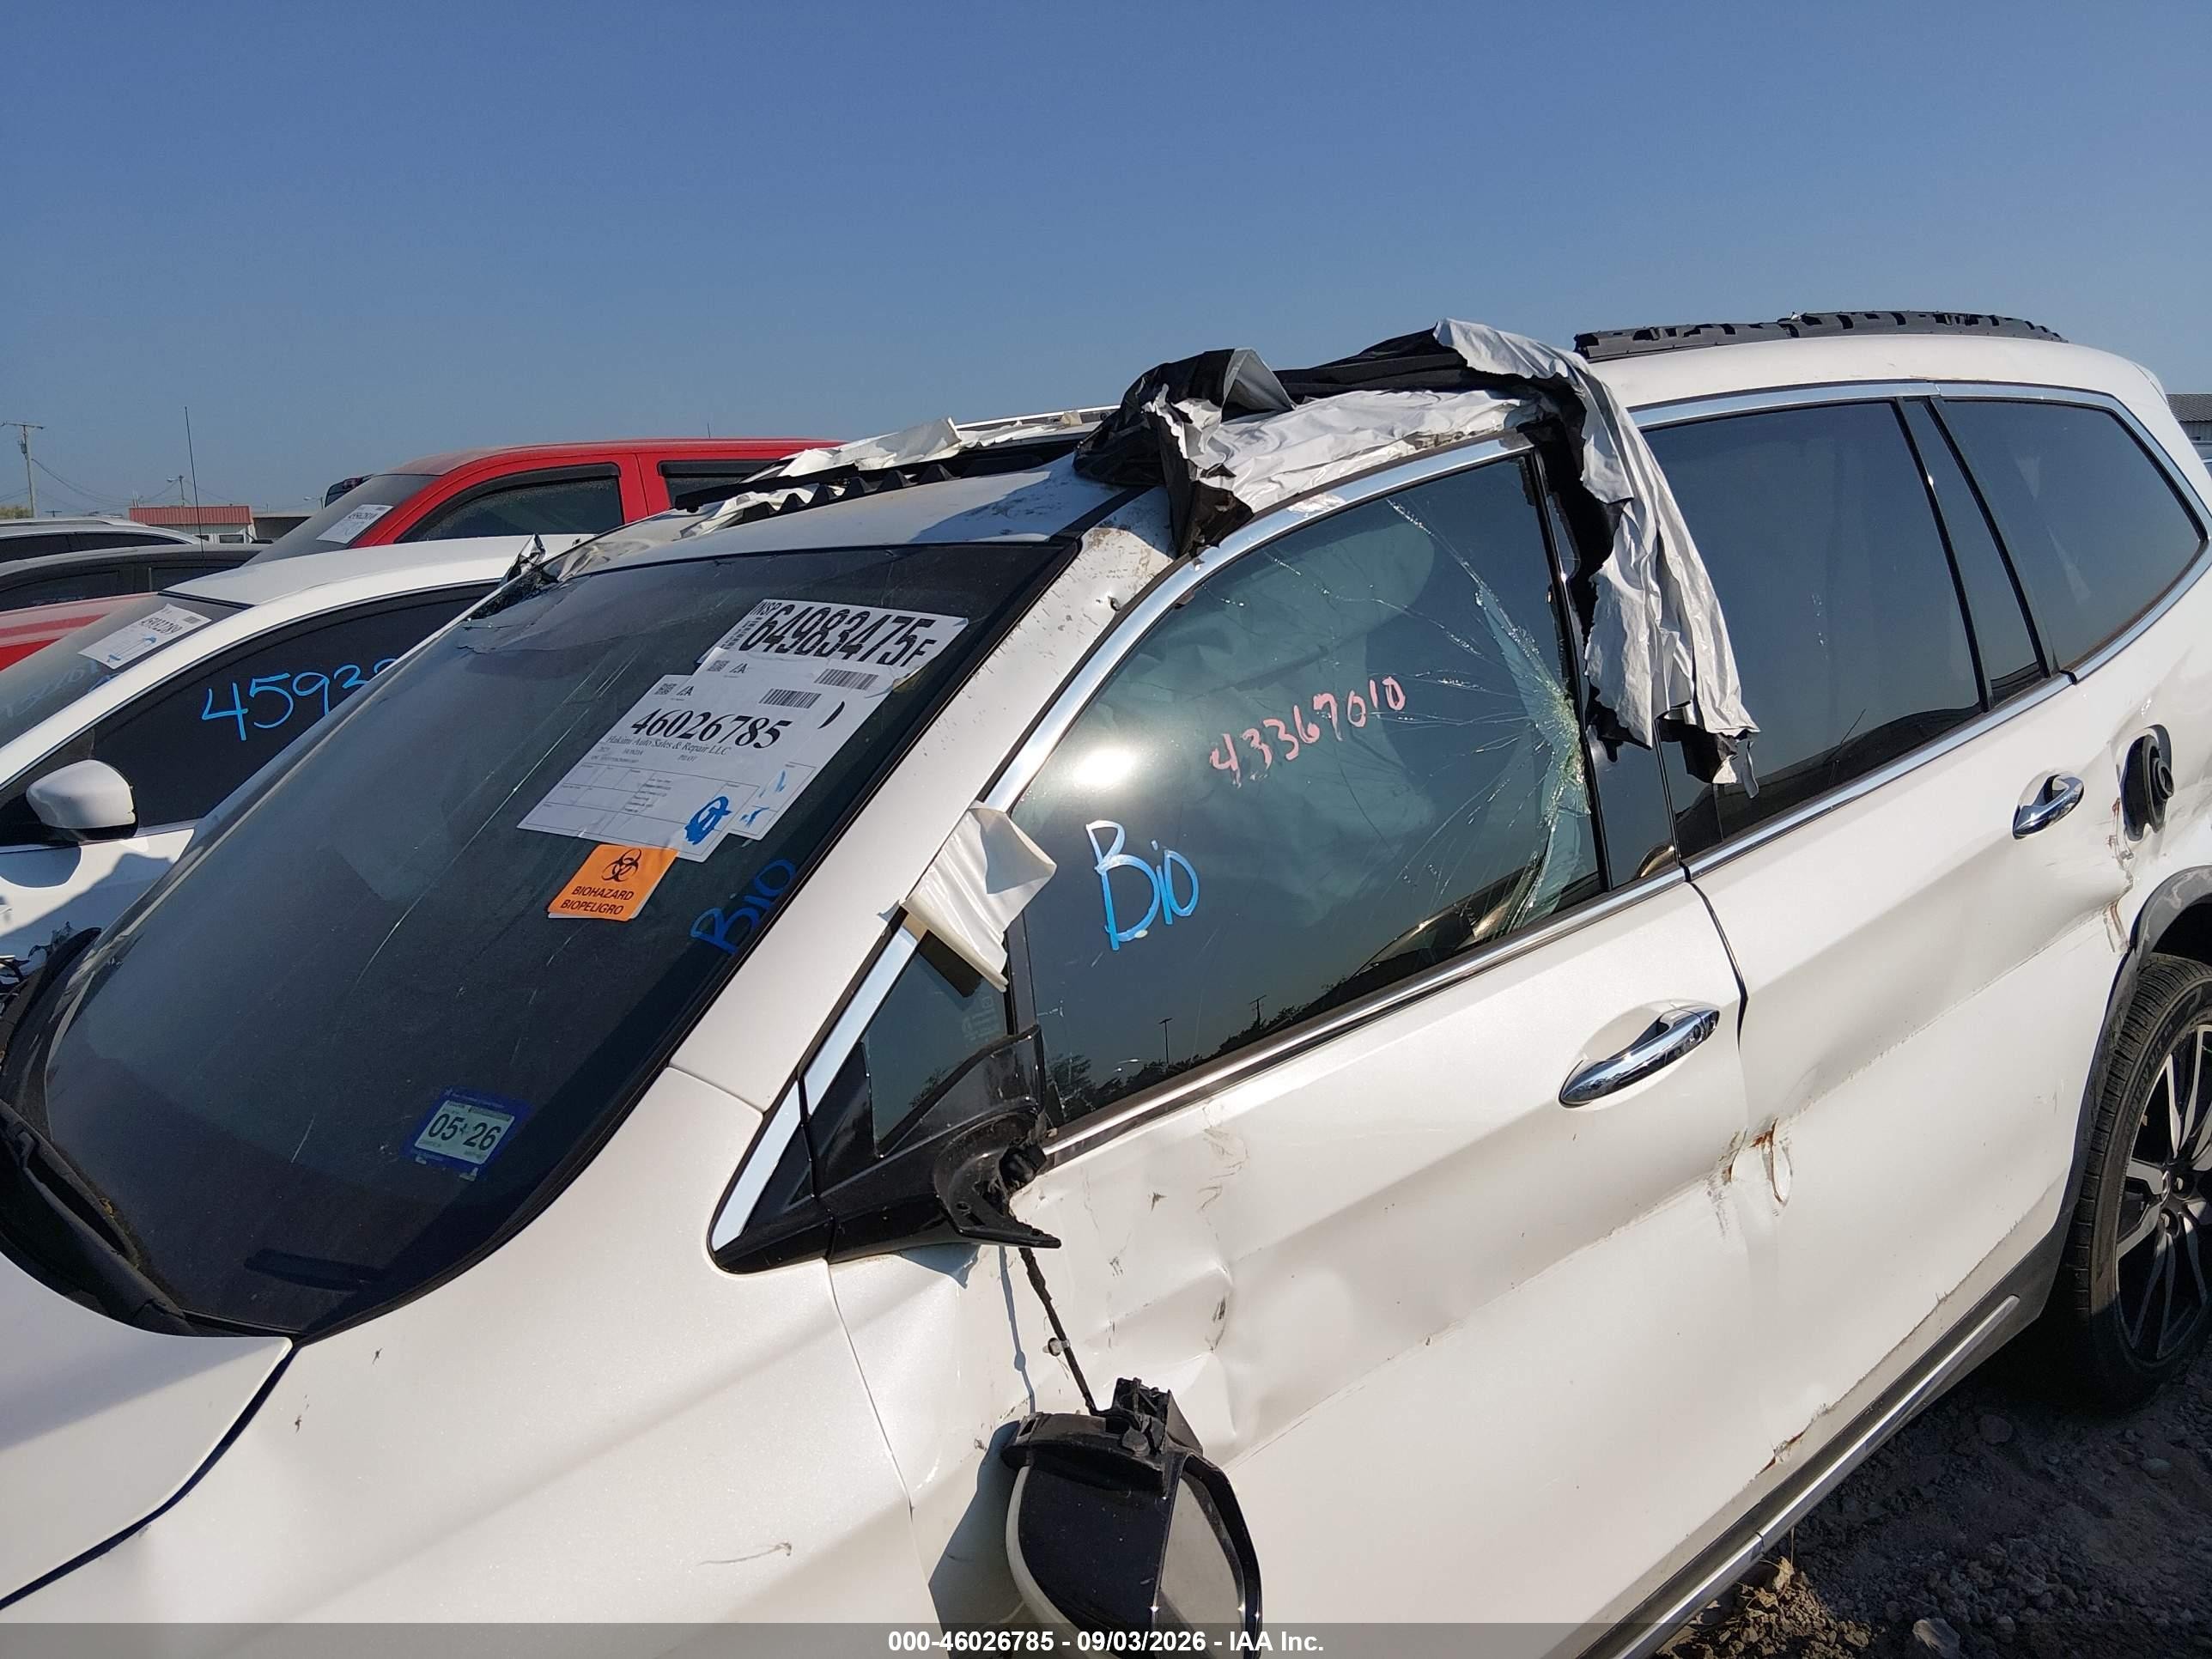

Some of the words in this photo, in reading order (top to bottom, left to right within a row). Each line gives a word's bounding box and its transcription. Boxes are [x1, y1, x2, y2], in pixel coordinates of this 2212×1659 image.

[630, 708, 793, 749] 46026785
[1209, 675, 1407, 788] 43367010
[632, 737, 652, 748] Auto
[653, 738, 672, 749] Sales
[682, 742, 709, 755] Repair
[708, 745, 732, 756] LLC
[571, 885, 635, 902] BIOHAZARD
[560, 898, 625, 915] BIOPELIGRO
